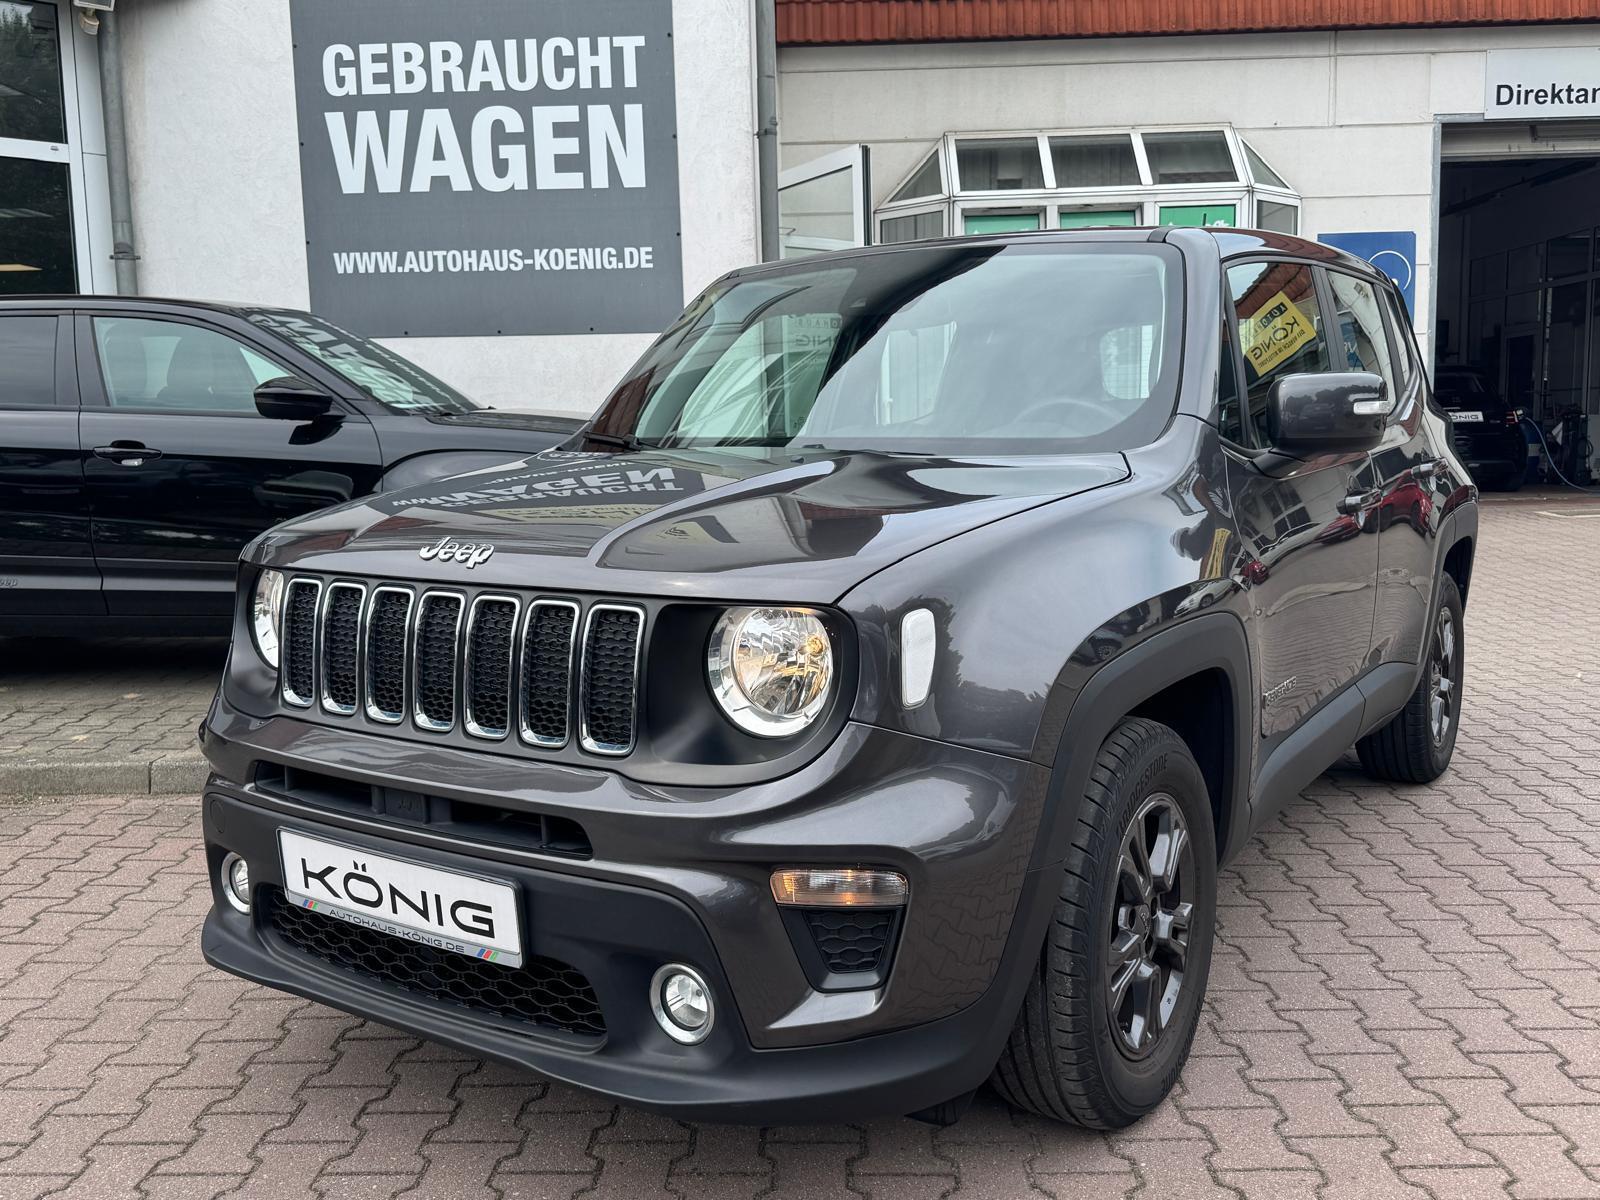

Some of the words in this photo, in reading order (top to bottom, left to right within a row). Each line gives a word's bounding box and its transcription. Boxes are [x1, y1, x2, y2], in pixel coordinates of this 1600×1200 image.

[322, 35, 646, 97] GEBRAUCHT
[323, 103, 647, 194] WAGEN
[333, 247, 654, 274] WWW.AUTOHAUS-KOENIG.DE
[419, 536, 495, 569] Jeep
[301, 858, 495, 939] KÖNIG
